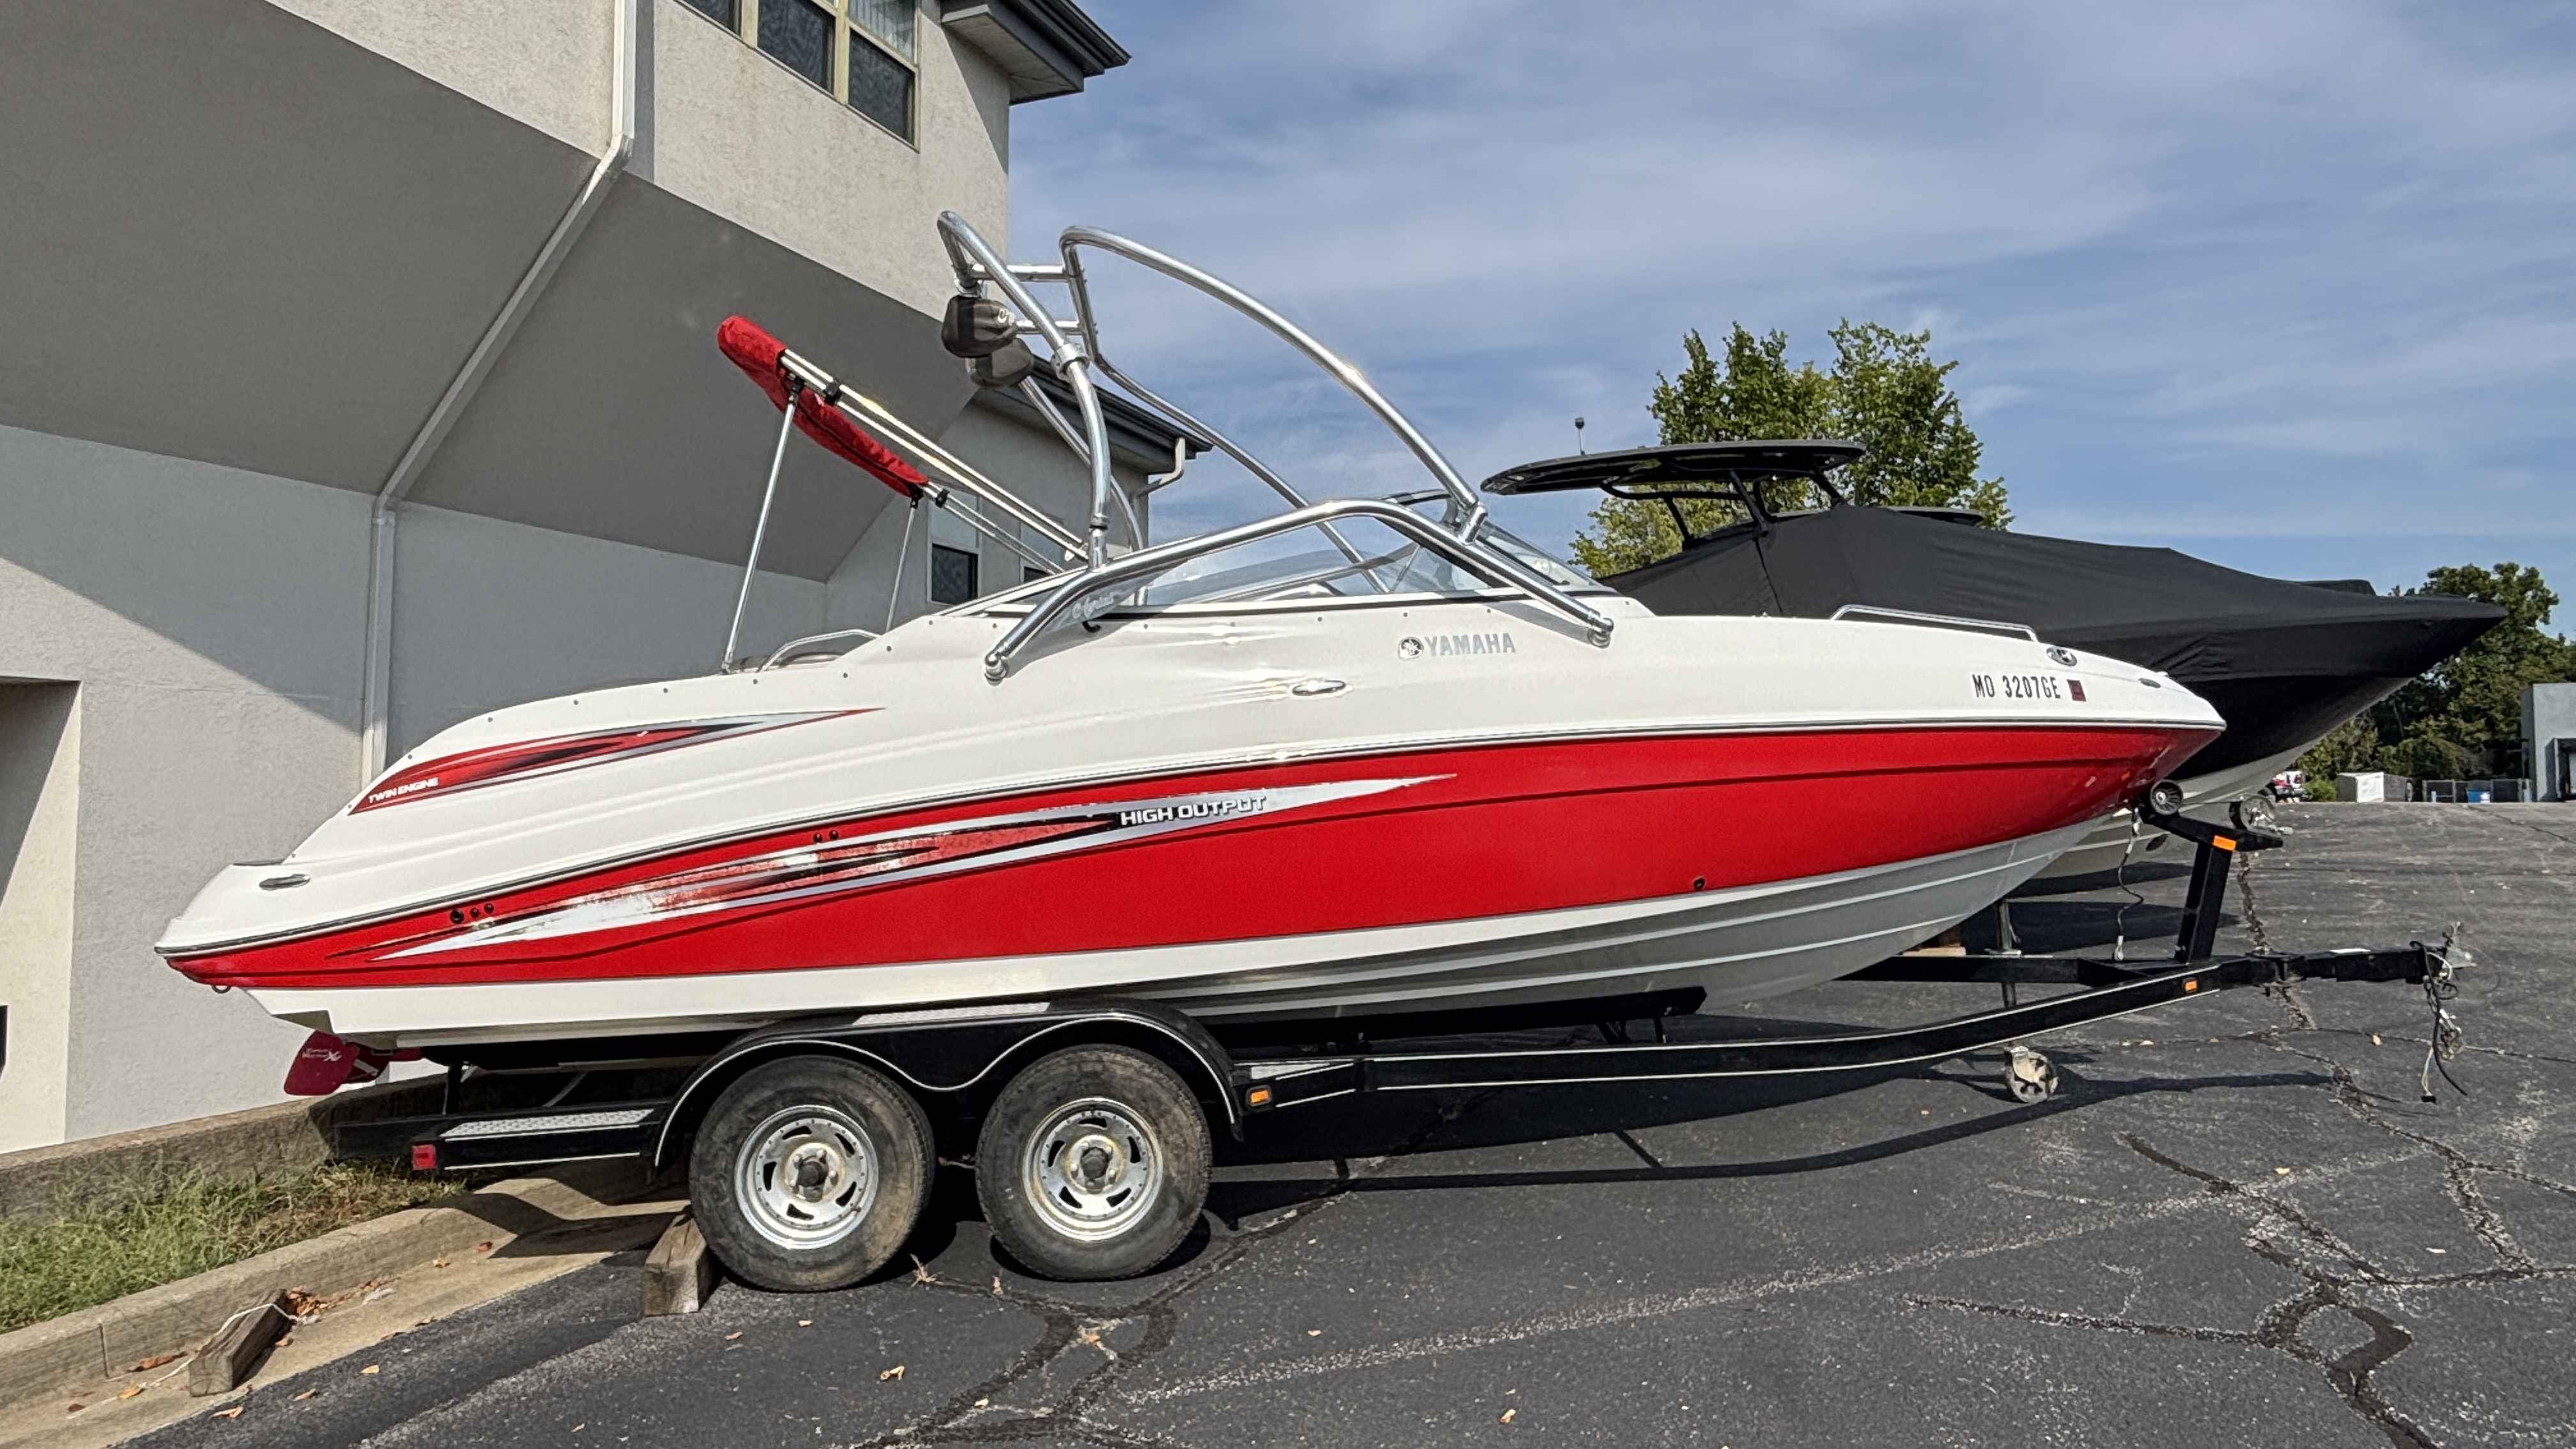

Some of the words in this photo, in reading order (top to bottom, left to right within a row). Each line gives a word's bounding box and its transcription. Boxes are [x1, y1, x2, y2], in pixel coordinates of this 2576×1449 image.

[1425, 632, 1515, 656] YAMAHA
[1972, 674, 1995, 698] MO
[2002, 675, 2061, 699] 3207GE
[369, 787, 397, 803] TWIN
[397, 777, 439, 795] ENGINE
[1120, 806, 1174, 825] HIGH
[1178, 796, 1266, 818] OUTPUT
